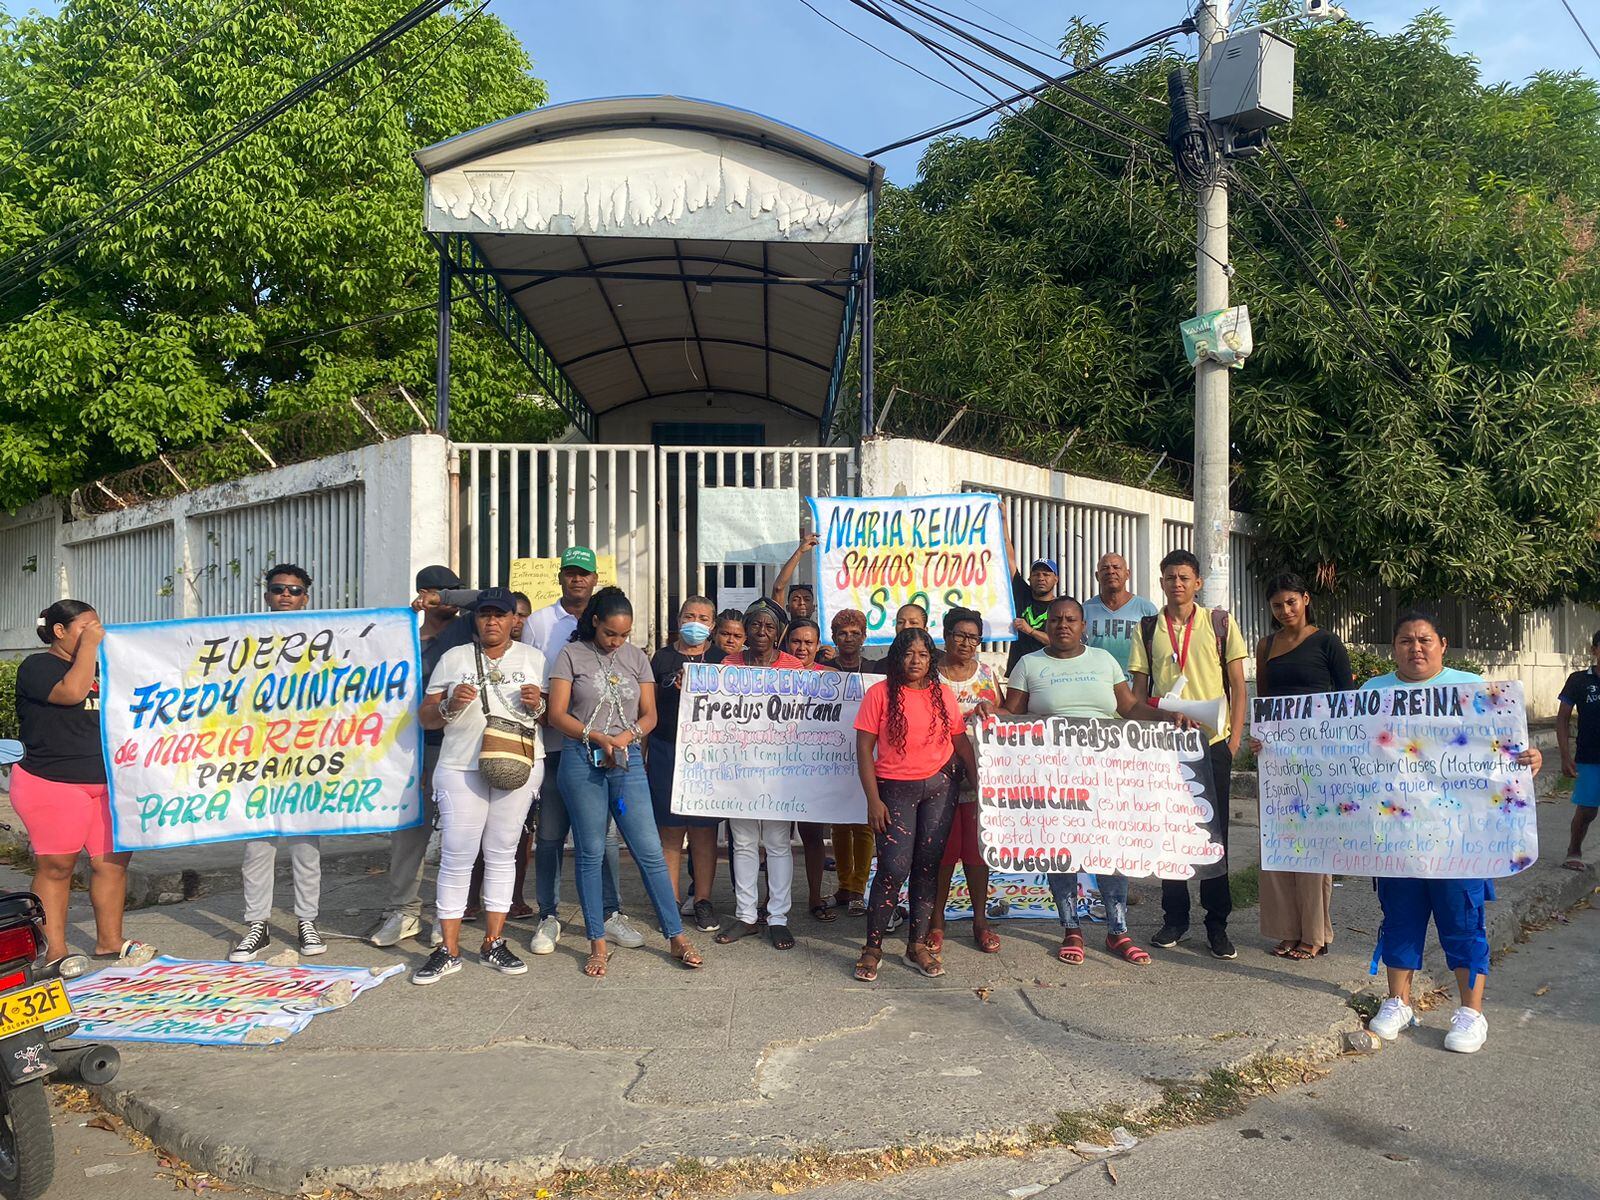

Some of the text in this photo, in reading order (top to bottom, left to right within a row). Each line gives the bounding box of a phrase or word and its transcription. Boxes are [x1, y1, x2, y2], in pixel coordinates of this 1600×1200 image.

[825, 505, 904, 553] MARIA
[910, 502, 992, 548] REINA
[836, 549, 992, 590] SOMOS TODOS
[130, 660, 410, 729] FREDY QUINTANA
[688, 665, 866, 701] NO QUEREMOS A
[692, 695, 842, 724] Fredys Quintana
[1253, 695, 1313, 723] MARIA
[1390, 686, 1464, 716] REINA
[115, 712, 384, 767] de MARIA REINA
[981, 717, 1200, 752] Fuera Fredys Quintana
[1257, 723, 1296, 745] Sedes
[1300, 728, 1318, 741] en
[684, 744, 696, 763] 6
[1017, 753, 1031, 767] se
[1034, 752, 1070, 767] siente
[1075, 752, 1098, 767] con
[1100, 754, 1172, 776] competencias
[1264, 759, 1322, 777] Estudiantes
[1329, 762, 1347, 776] sin
[1350, 756, 1396, 777] Recibir
[1398, 757, 1436, 775] Clases
[197, 751, 346, 789] PARAMOS
[1045, 773, 1053, 788] y
[1056, 769, 1069, 786] la
[1071, 770, 1099, 787] edad
[1103, 772, 1114, 787] le
[1115, 776, 1146, 794] pasa
[1147, 774, 1192, 794] factura
[981, 787, 1208, 818] RENUNCIAR es un buen Camino
[1330, 780, 1380, 802] persigue
[1385, 782, 1395, 792] a
[1400, 778, 1437, 801] quien
[1440, 779, 1489, 800] piensa
[136, 789, 231, 833] PARA
[982, 813, 1198, 835] antes de que sea demasiado tarde
[983, 831, 994, 843] a
[997, 829, 1033, 845] usted
[1059, 831, 1111, 847] conocen
[1117, 836, 1154, 850] como
[1161, 839, 1177, 854] el
[1181, 841, 1226, 858] acaba
[1083, 851, 1112, 869] debe
[1115, 852, 1152, 872] darle
[1156, 860, 1193, 879] pena
[17, 985, 60, 1018] 32F
[2, 1016, 39, 1032] COLOMBIA
